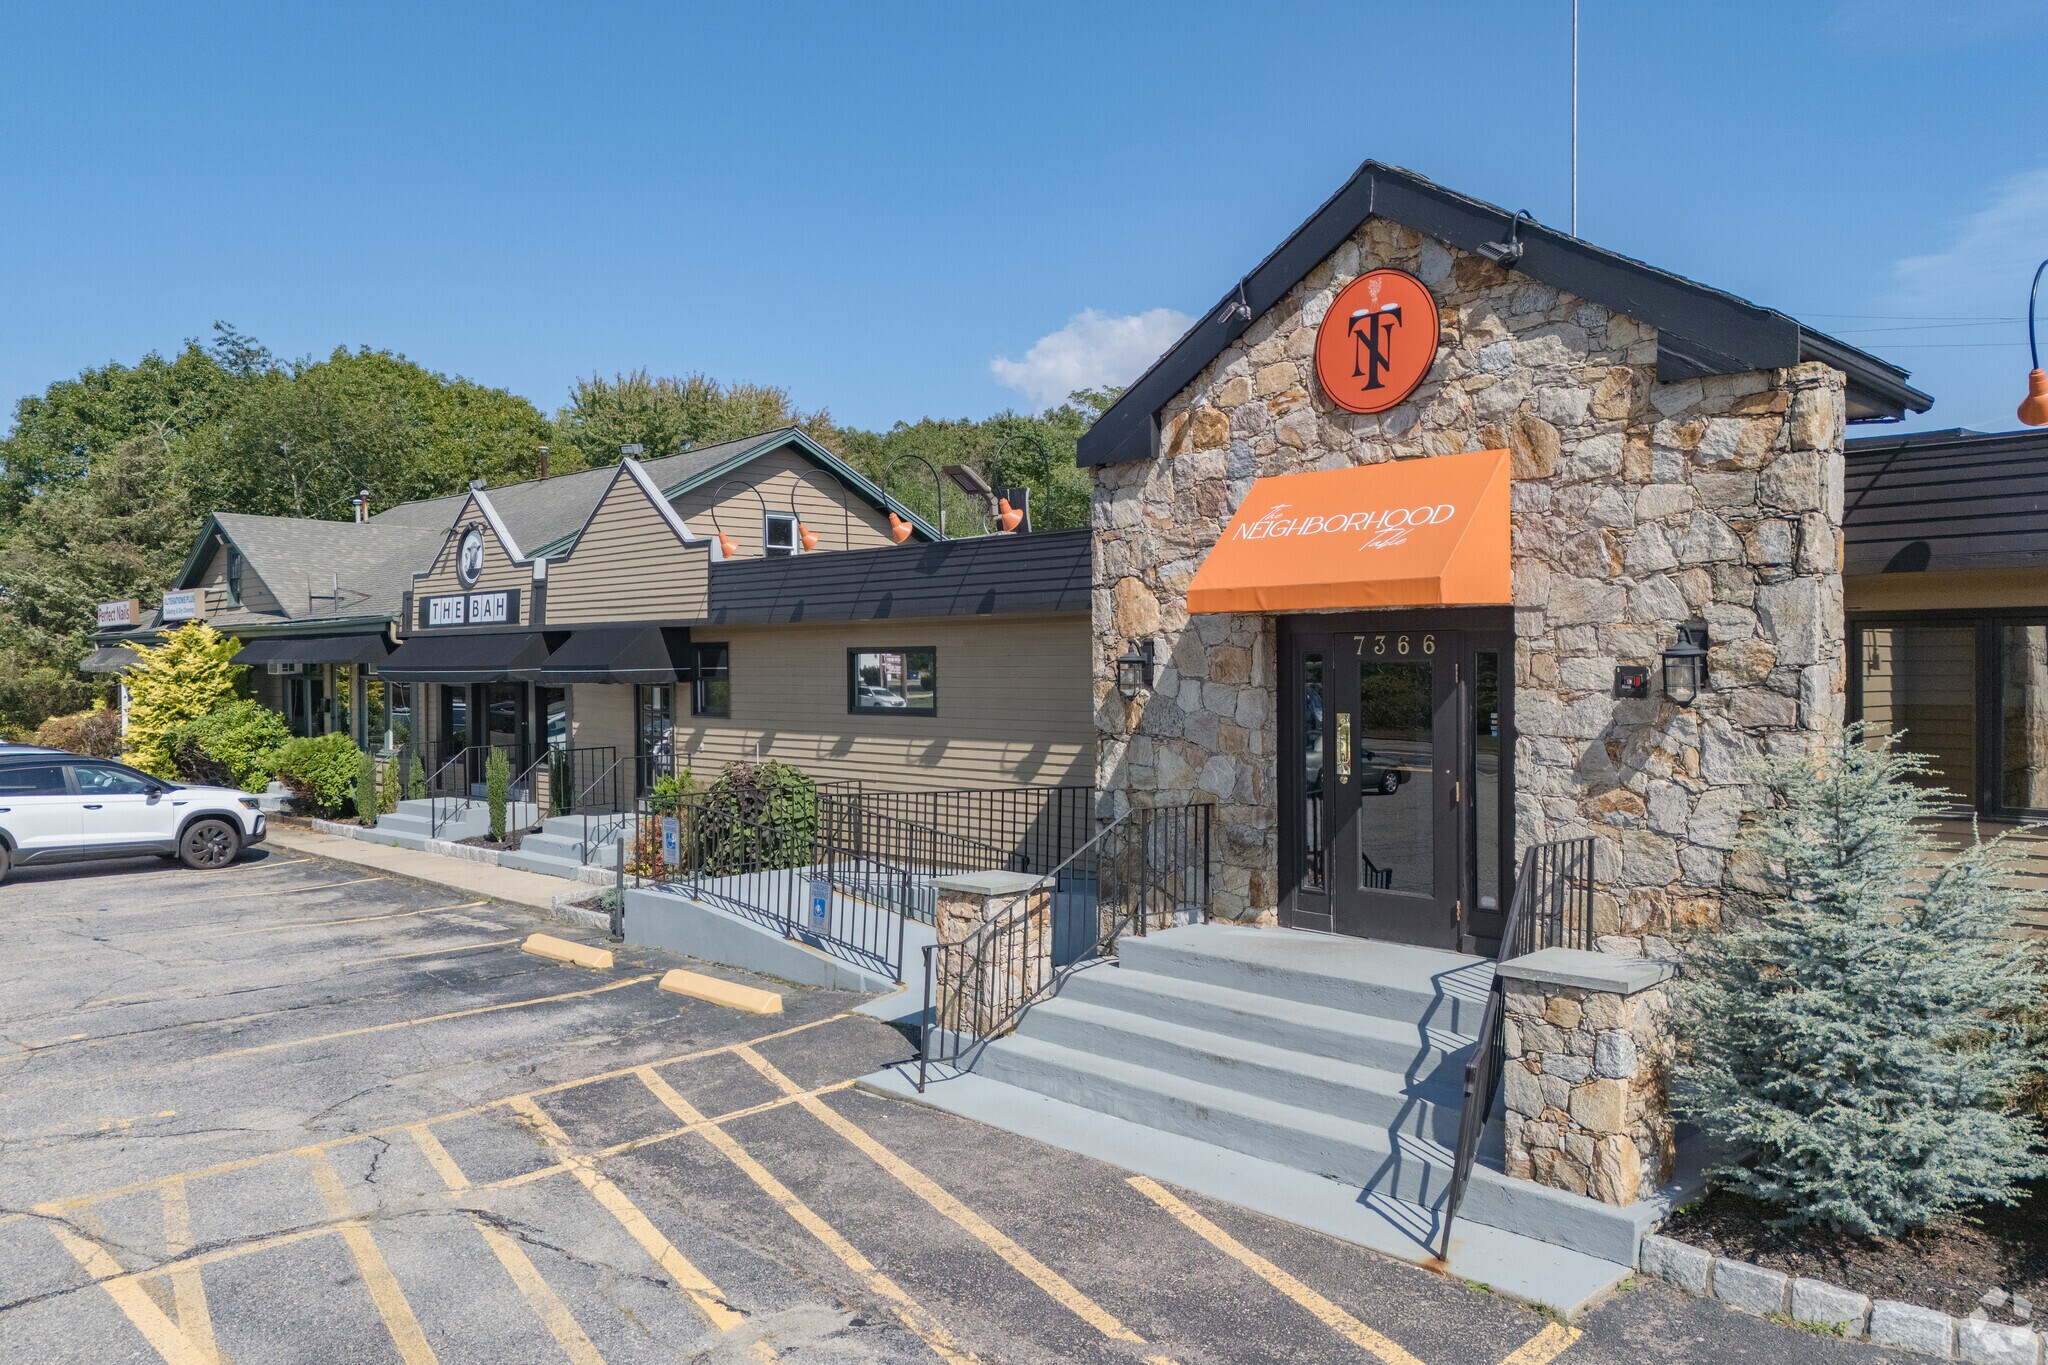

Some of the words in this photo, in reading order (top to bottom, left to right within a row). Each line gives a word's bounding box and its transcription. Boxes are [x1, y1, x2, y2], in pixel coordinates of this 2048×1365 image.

[1232, 504, 1455, 541] NEIGHBORHOOD
[1259, 503, 1293, 522] The
[1358, 526, 1415, 552] Table
[98, 606, 116, 623] Perfect
[116, 604, 130, 620] Nails
[433, 601, 461, 620] THE
[472, 598, 504, 618] BAH
[1353, 634, 1436, 655] 7366
